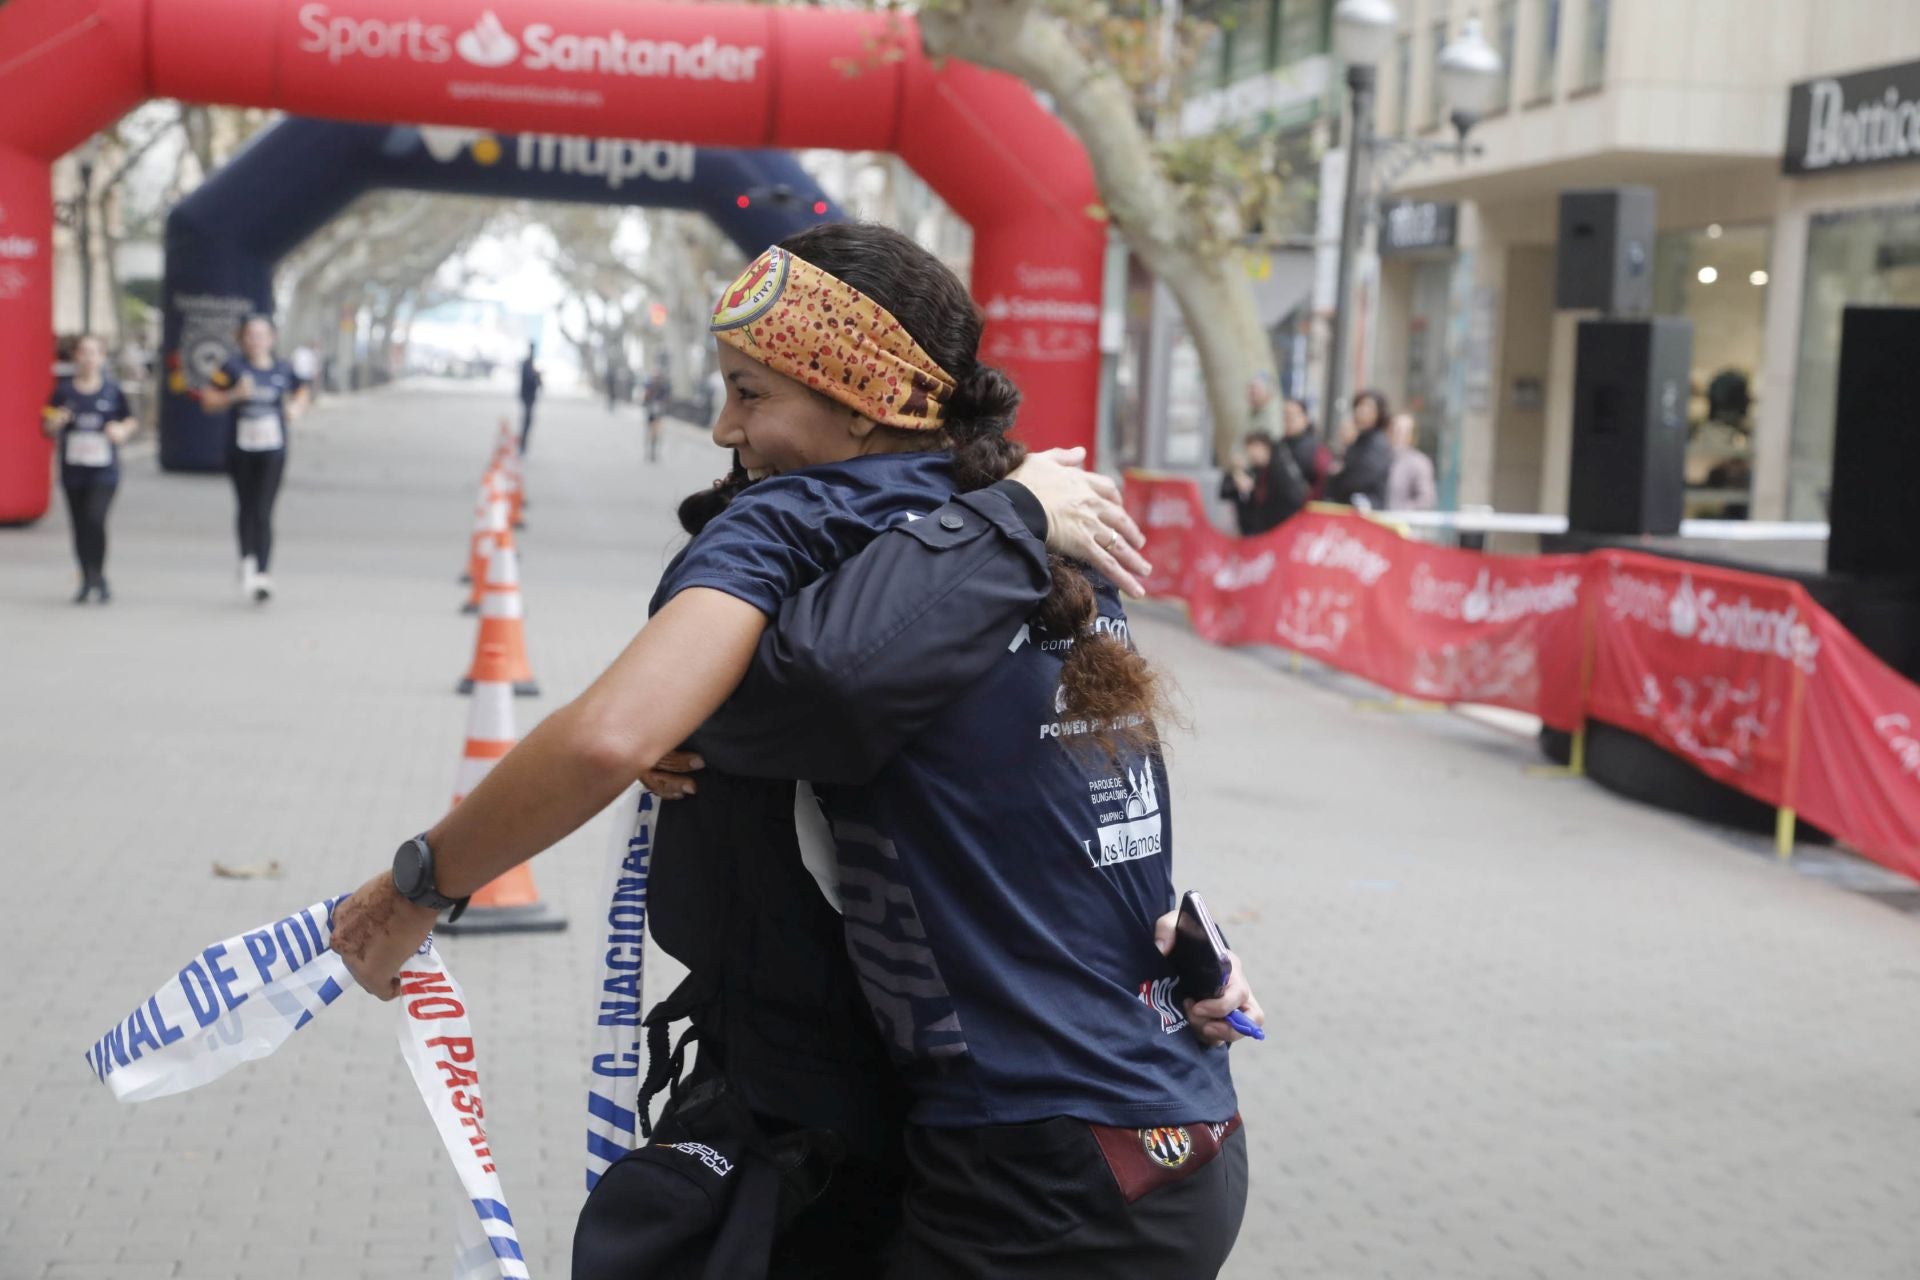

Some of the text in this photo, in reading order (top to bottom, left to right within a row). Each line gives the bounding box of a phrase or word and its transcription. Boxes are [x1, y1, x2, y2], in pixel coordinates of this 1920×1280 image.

[298, 3, 764, 82] Sports Santander
[1039, 719, 1088, 740] POWER
[1088, 777, 1123, 792] PARQUE DE
[1090, 789, 1128, 804] BUNGALOWS
[1099, 811, 1124, 824] CAMPING
[591, 824, 649, 1078] C. NACIONAL
[178, 943, 248, 1029] DE
[400, 970, 465, 1021] NO
